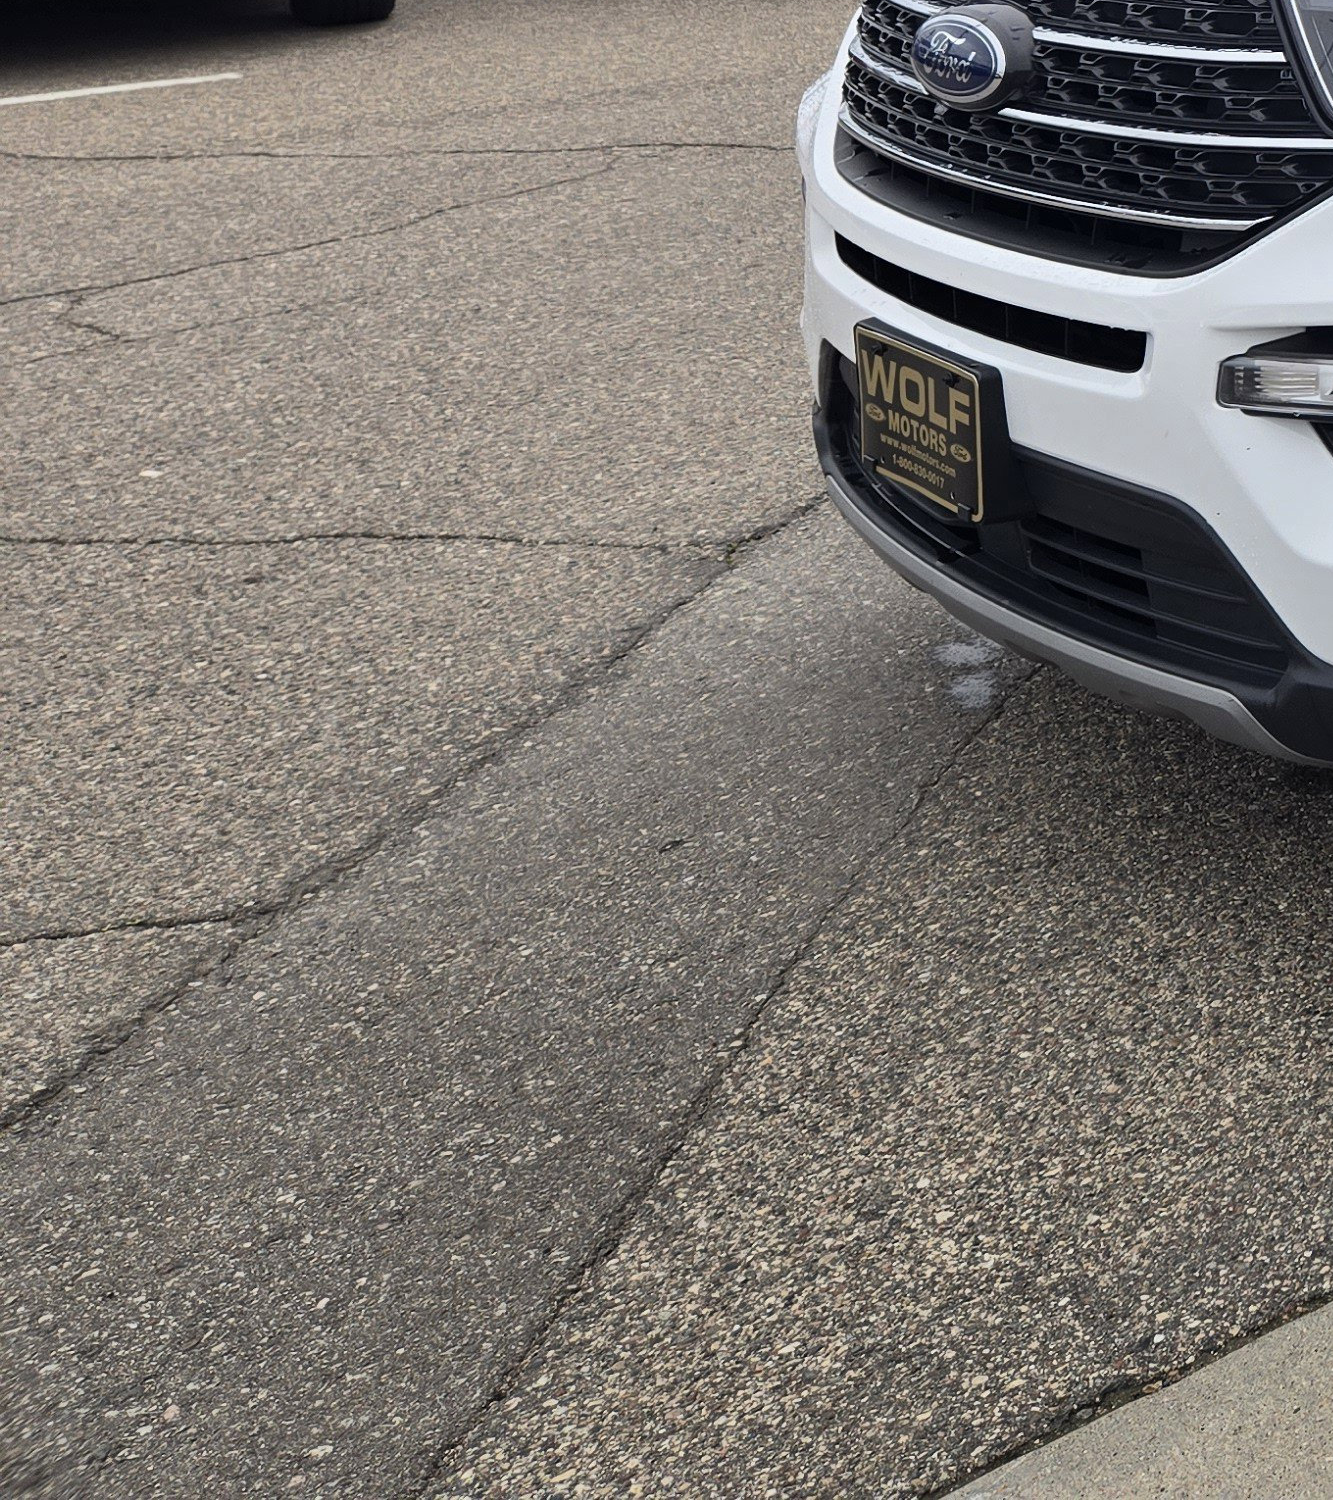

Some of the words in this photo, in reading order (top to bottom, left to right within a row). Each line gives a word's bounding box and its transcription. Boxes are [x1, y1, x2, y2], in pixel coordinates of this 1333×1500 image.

[922, 30, 977, 83] Ford
[862, 350, 970, 435] WOLF
[888, 409, 948, 457] MOTORS
